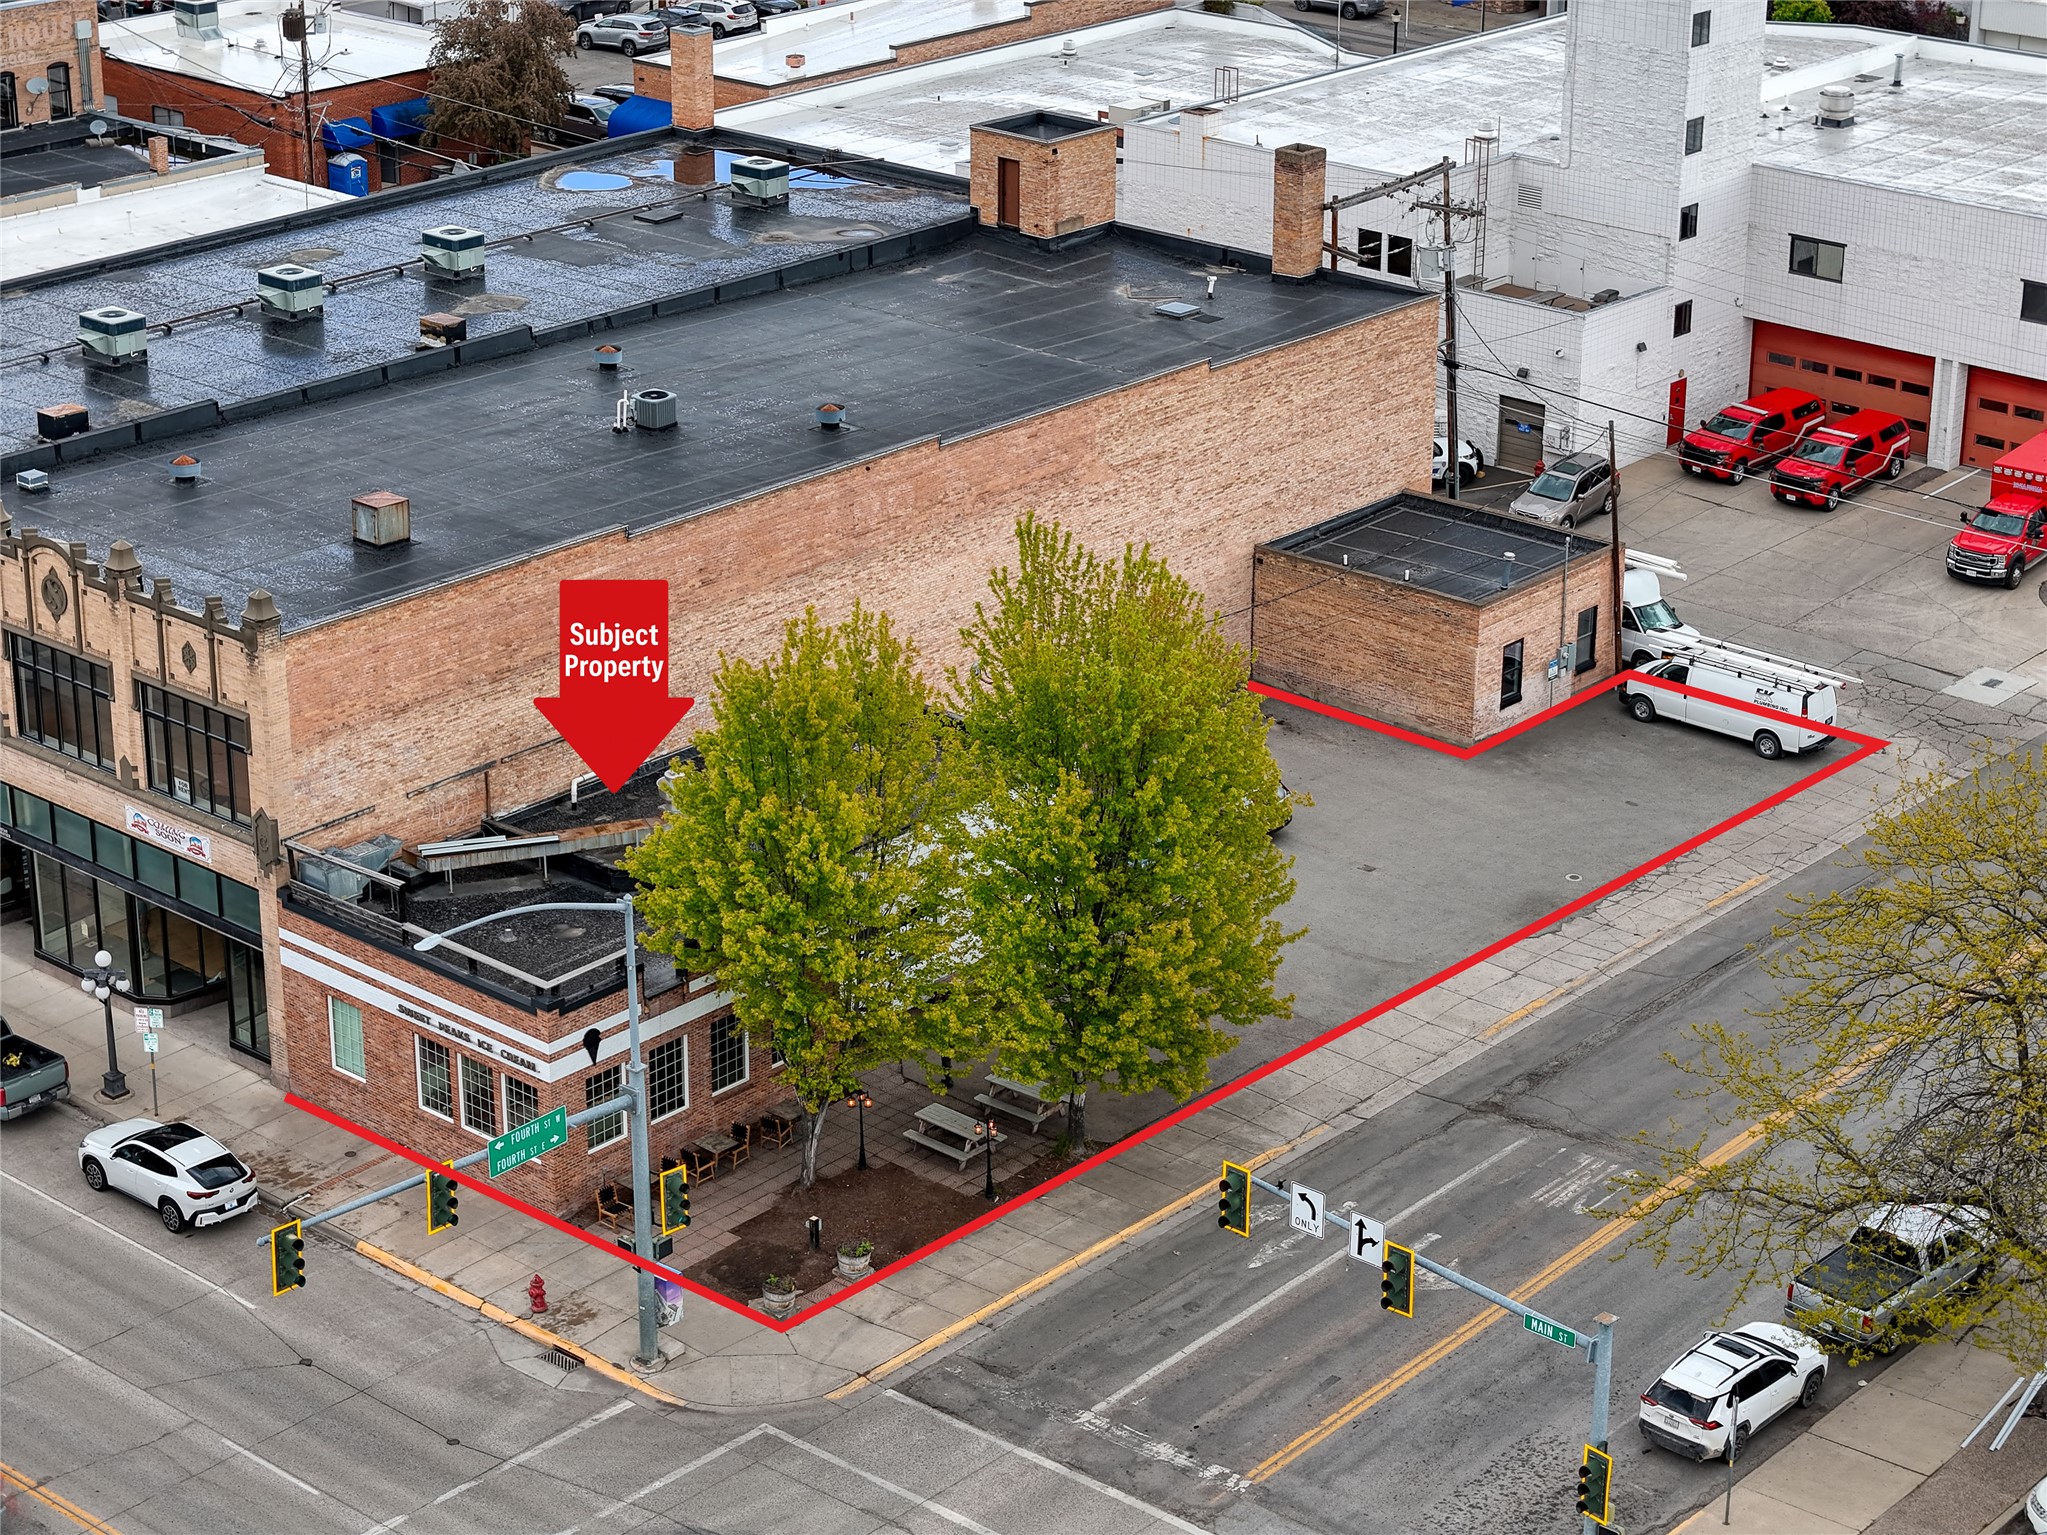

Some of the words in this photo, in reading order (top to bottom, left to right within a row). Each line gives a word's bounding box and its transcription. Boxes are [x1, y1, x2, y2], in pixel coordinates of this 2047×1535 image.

[1754, 699, 1779, 710] PLUMBING
[147, 818, 186, 840] COMING
[155, 829, 181, 845] SOON
[398, 1004, 431, 1025] SWEET
[438, 1022, 470, 1042] PEAKS
[476, 1038, 494, 1053] ICE
[500, 1049, 537, 1072] CREAM
[511, 1122, 540, 1145] FOURTH
[543, 1118, 551, 1129] ST
[555, 1113, 561, 1123] W
[497, 1148, 526, 1172] FOURTH
[529, 1145, 537, 1156] ST
[541, 1141, 546, 1151] E
[1294, 1216, 1319, 1233] ONLY
[1531, 1318, 1554, 1338] MAIN
[1558, 1331, 1568, 1343] ST
